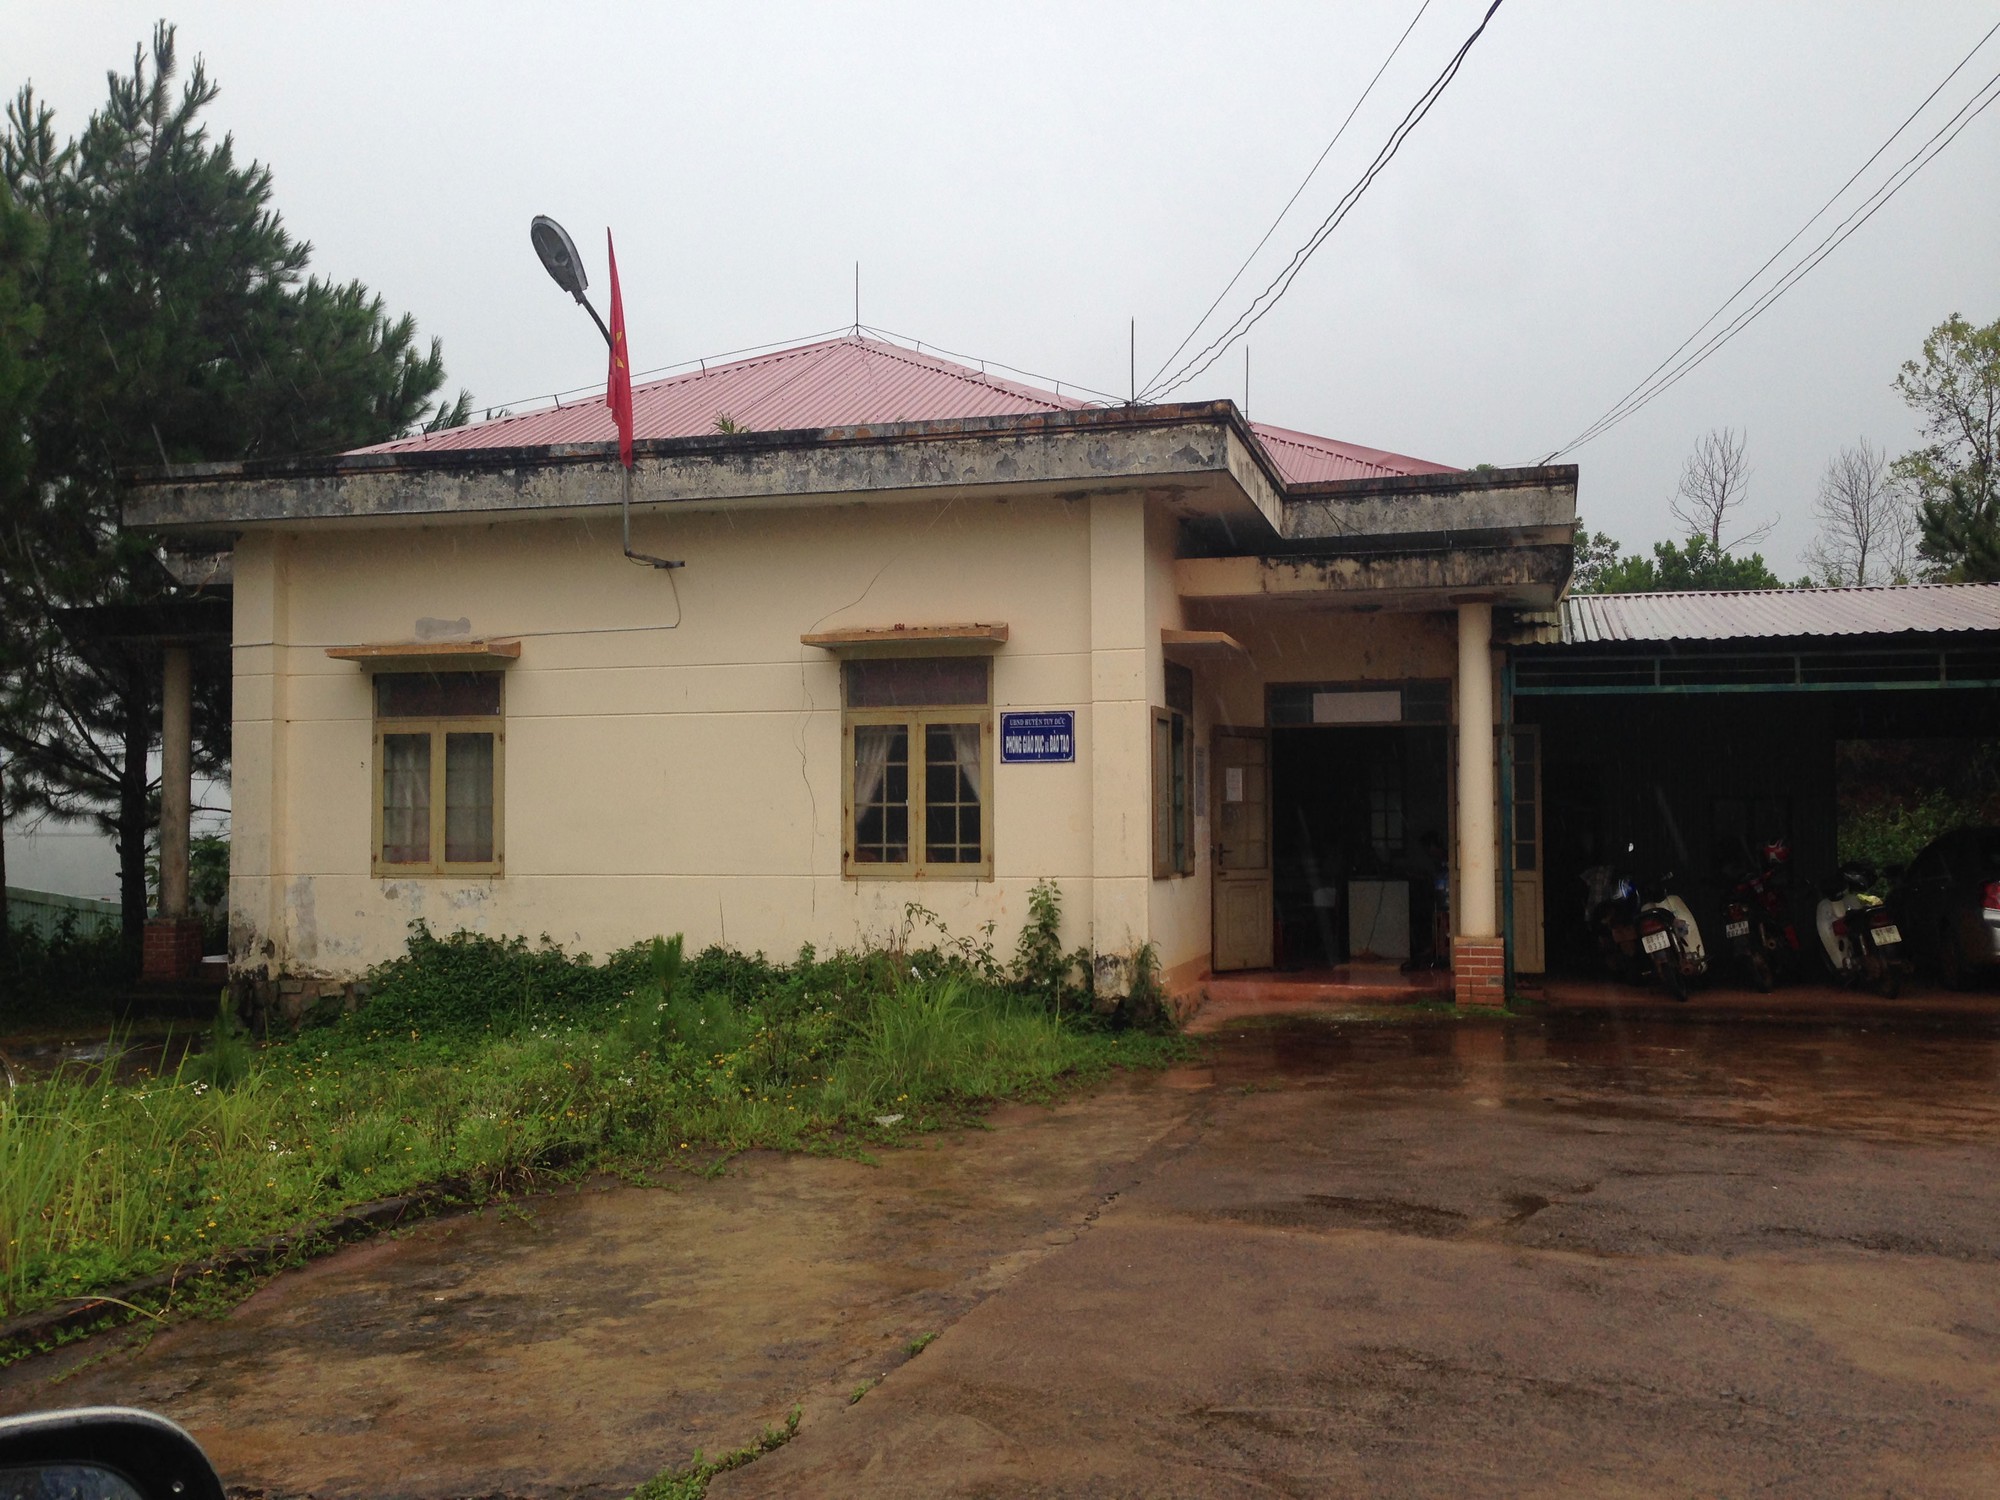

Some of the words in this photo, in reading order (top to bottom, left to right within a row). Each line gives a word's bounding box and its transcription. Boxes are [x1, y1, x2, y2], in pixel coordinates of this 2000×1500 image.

[1006, 730, 1022, 754] PHÒNG
[1022, 730, 1034, 754] GIÁO
[1034, 734, 1044, 758] DỤC
[1050, 729, 1060, 753] ĐÀO
[1060, 734, 1070, 758] TẠO
